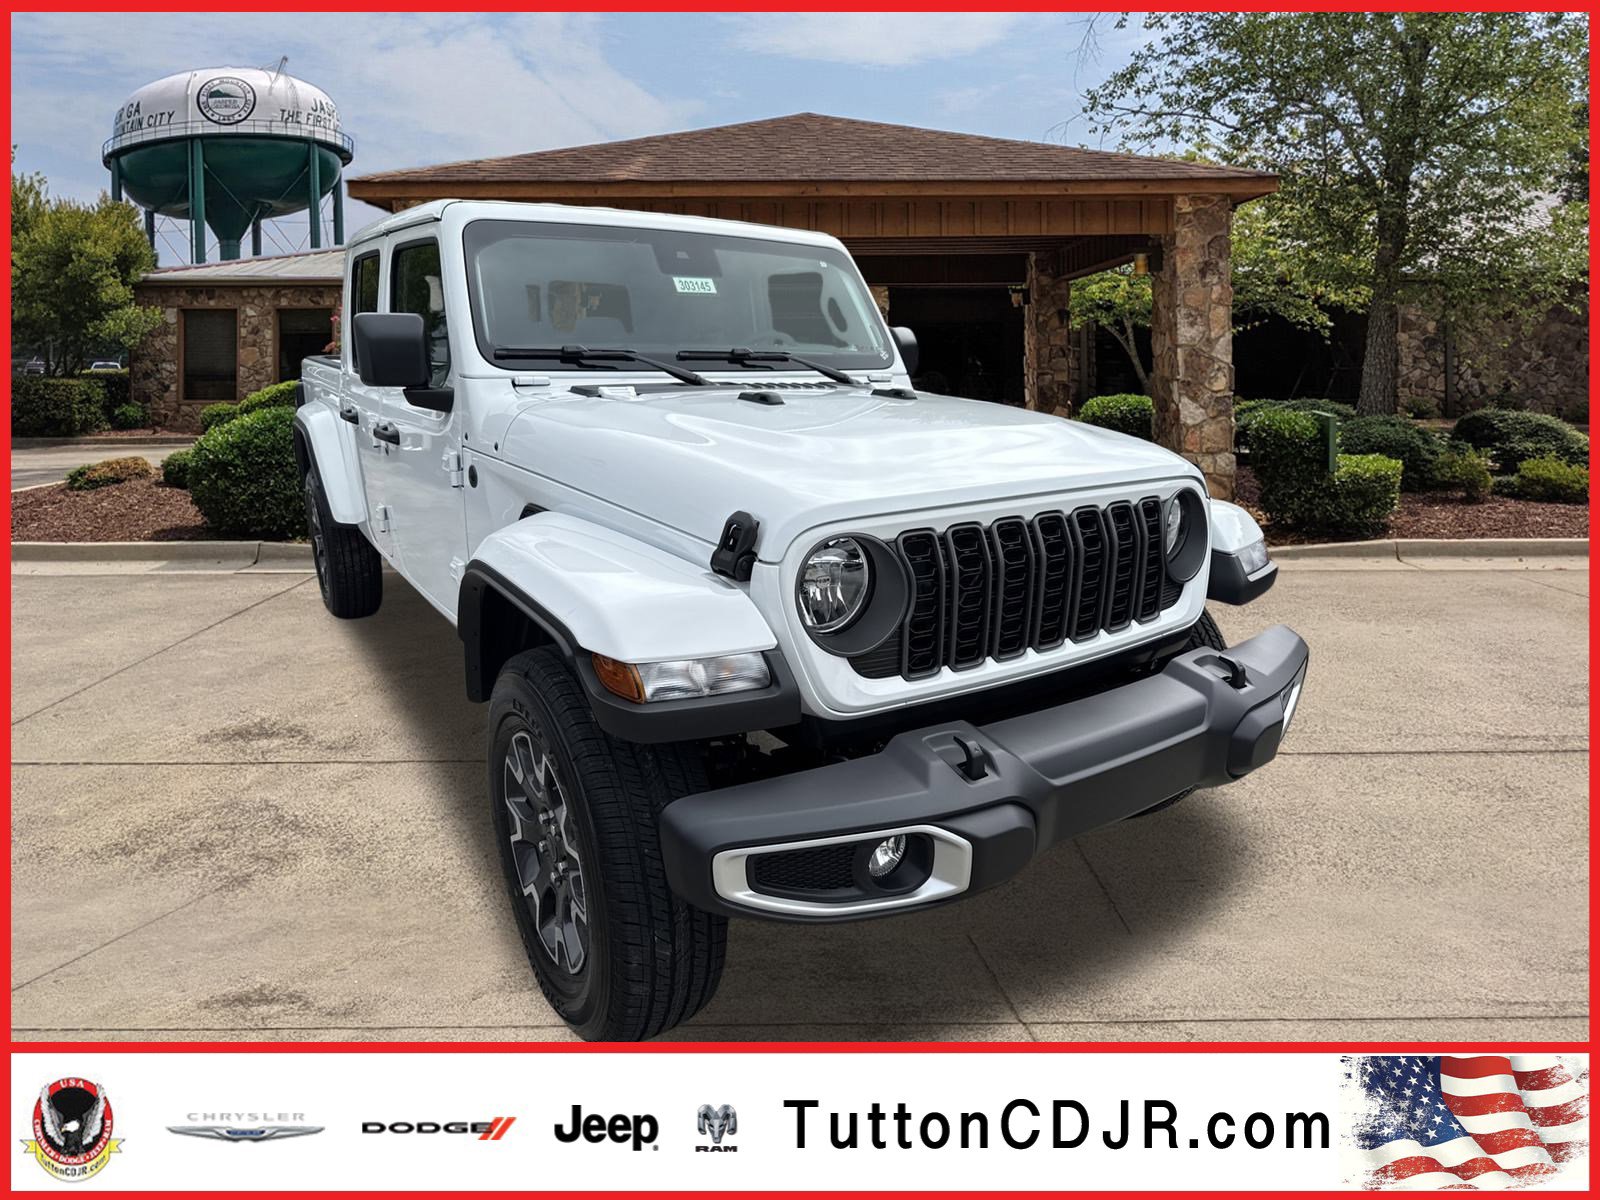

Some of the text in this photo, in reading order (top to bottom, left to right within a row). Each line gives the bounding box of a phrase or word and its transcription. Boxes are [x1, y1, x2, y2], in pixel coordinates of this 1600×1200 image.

[126, 101, 141, 119] GA
[146, 110, 176, 128] CITY
[280, 108, 302, 124] THE
[305, 112, 332, 131] FIRST
[678, 280, 711, 292] 303145
